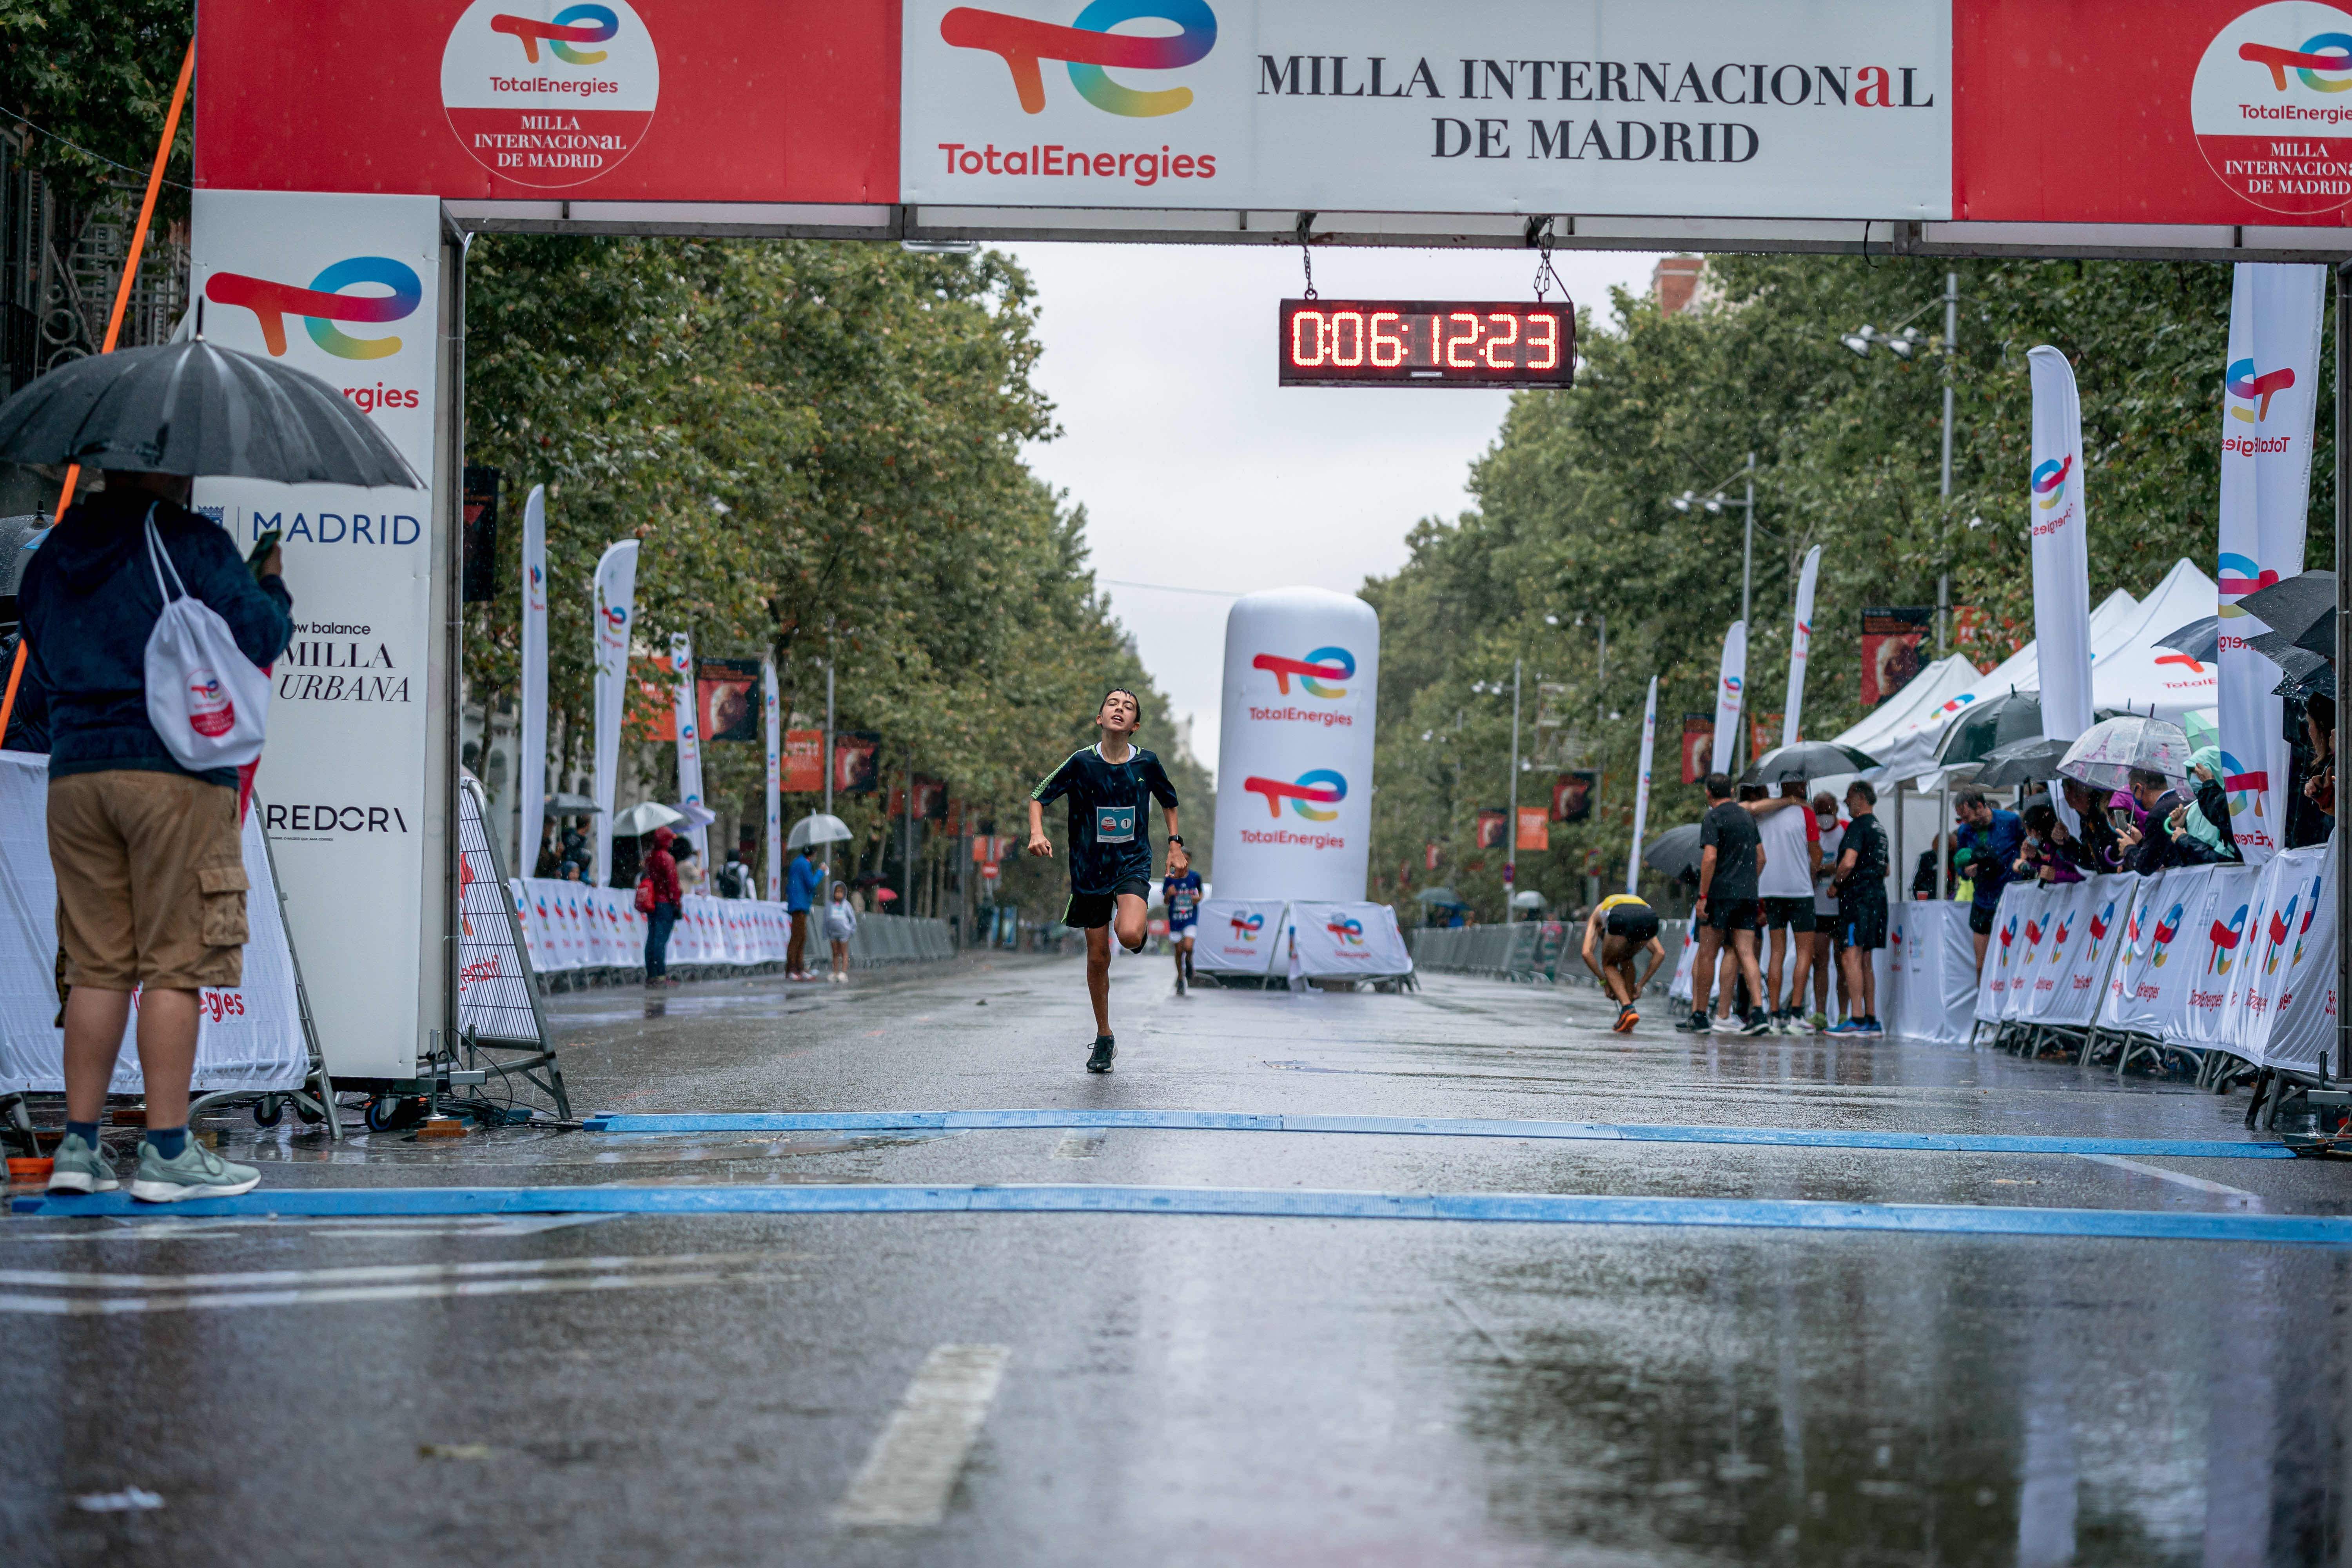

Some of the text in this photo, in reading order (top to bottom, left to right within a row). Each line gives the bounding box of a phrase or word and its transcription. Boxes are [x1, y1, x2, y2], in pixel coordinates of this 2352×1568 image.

[490, 77, 618, 97] TotalEnergies
[1257, 55, 1445, 99] MILLA
[521, 116, 581, 130] MILLA
[2239, 104, 2352, 124] TotalEnergie
[1431, 118, 1759, 163] DE MADRID
[2270, 143, 2329, 157] MILLA
[497, 153, 603, 168] DE MADRID
[938, 143, 1216, 186] TotalEnergies
[2225, 161, 2352, 176] INTERNACION
[2249, 180, 2351, 195] DE MADRID
[253, 512, 421, 546] MADRID
[312, 621, 371, 635] balance
[279, 642, 396, 668] MILLA
[279, 674, 411, 702] URBANA
[1250, 707, 1352, 727] TotalEnergies
[1124, 819, 1127, 828] 1
[1241, 830, 1345, 850] TotalEnergies
